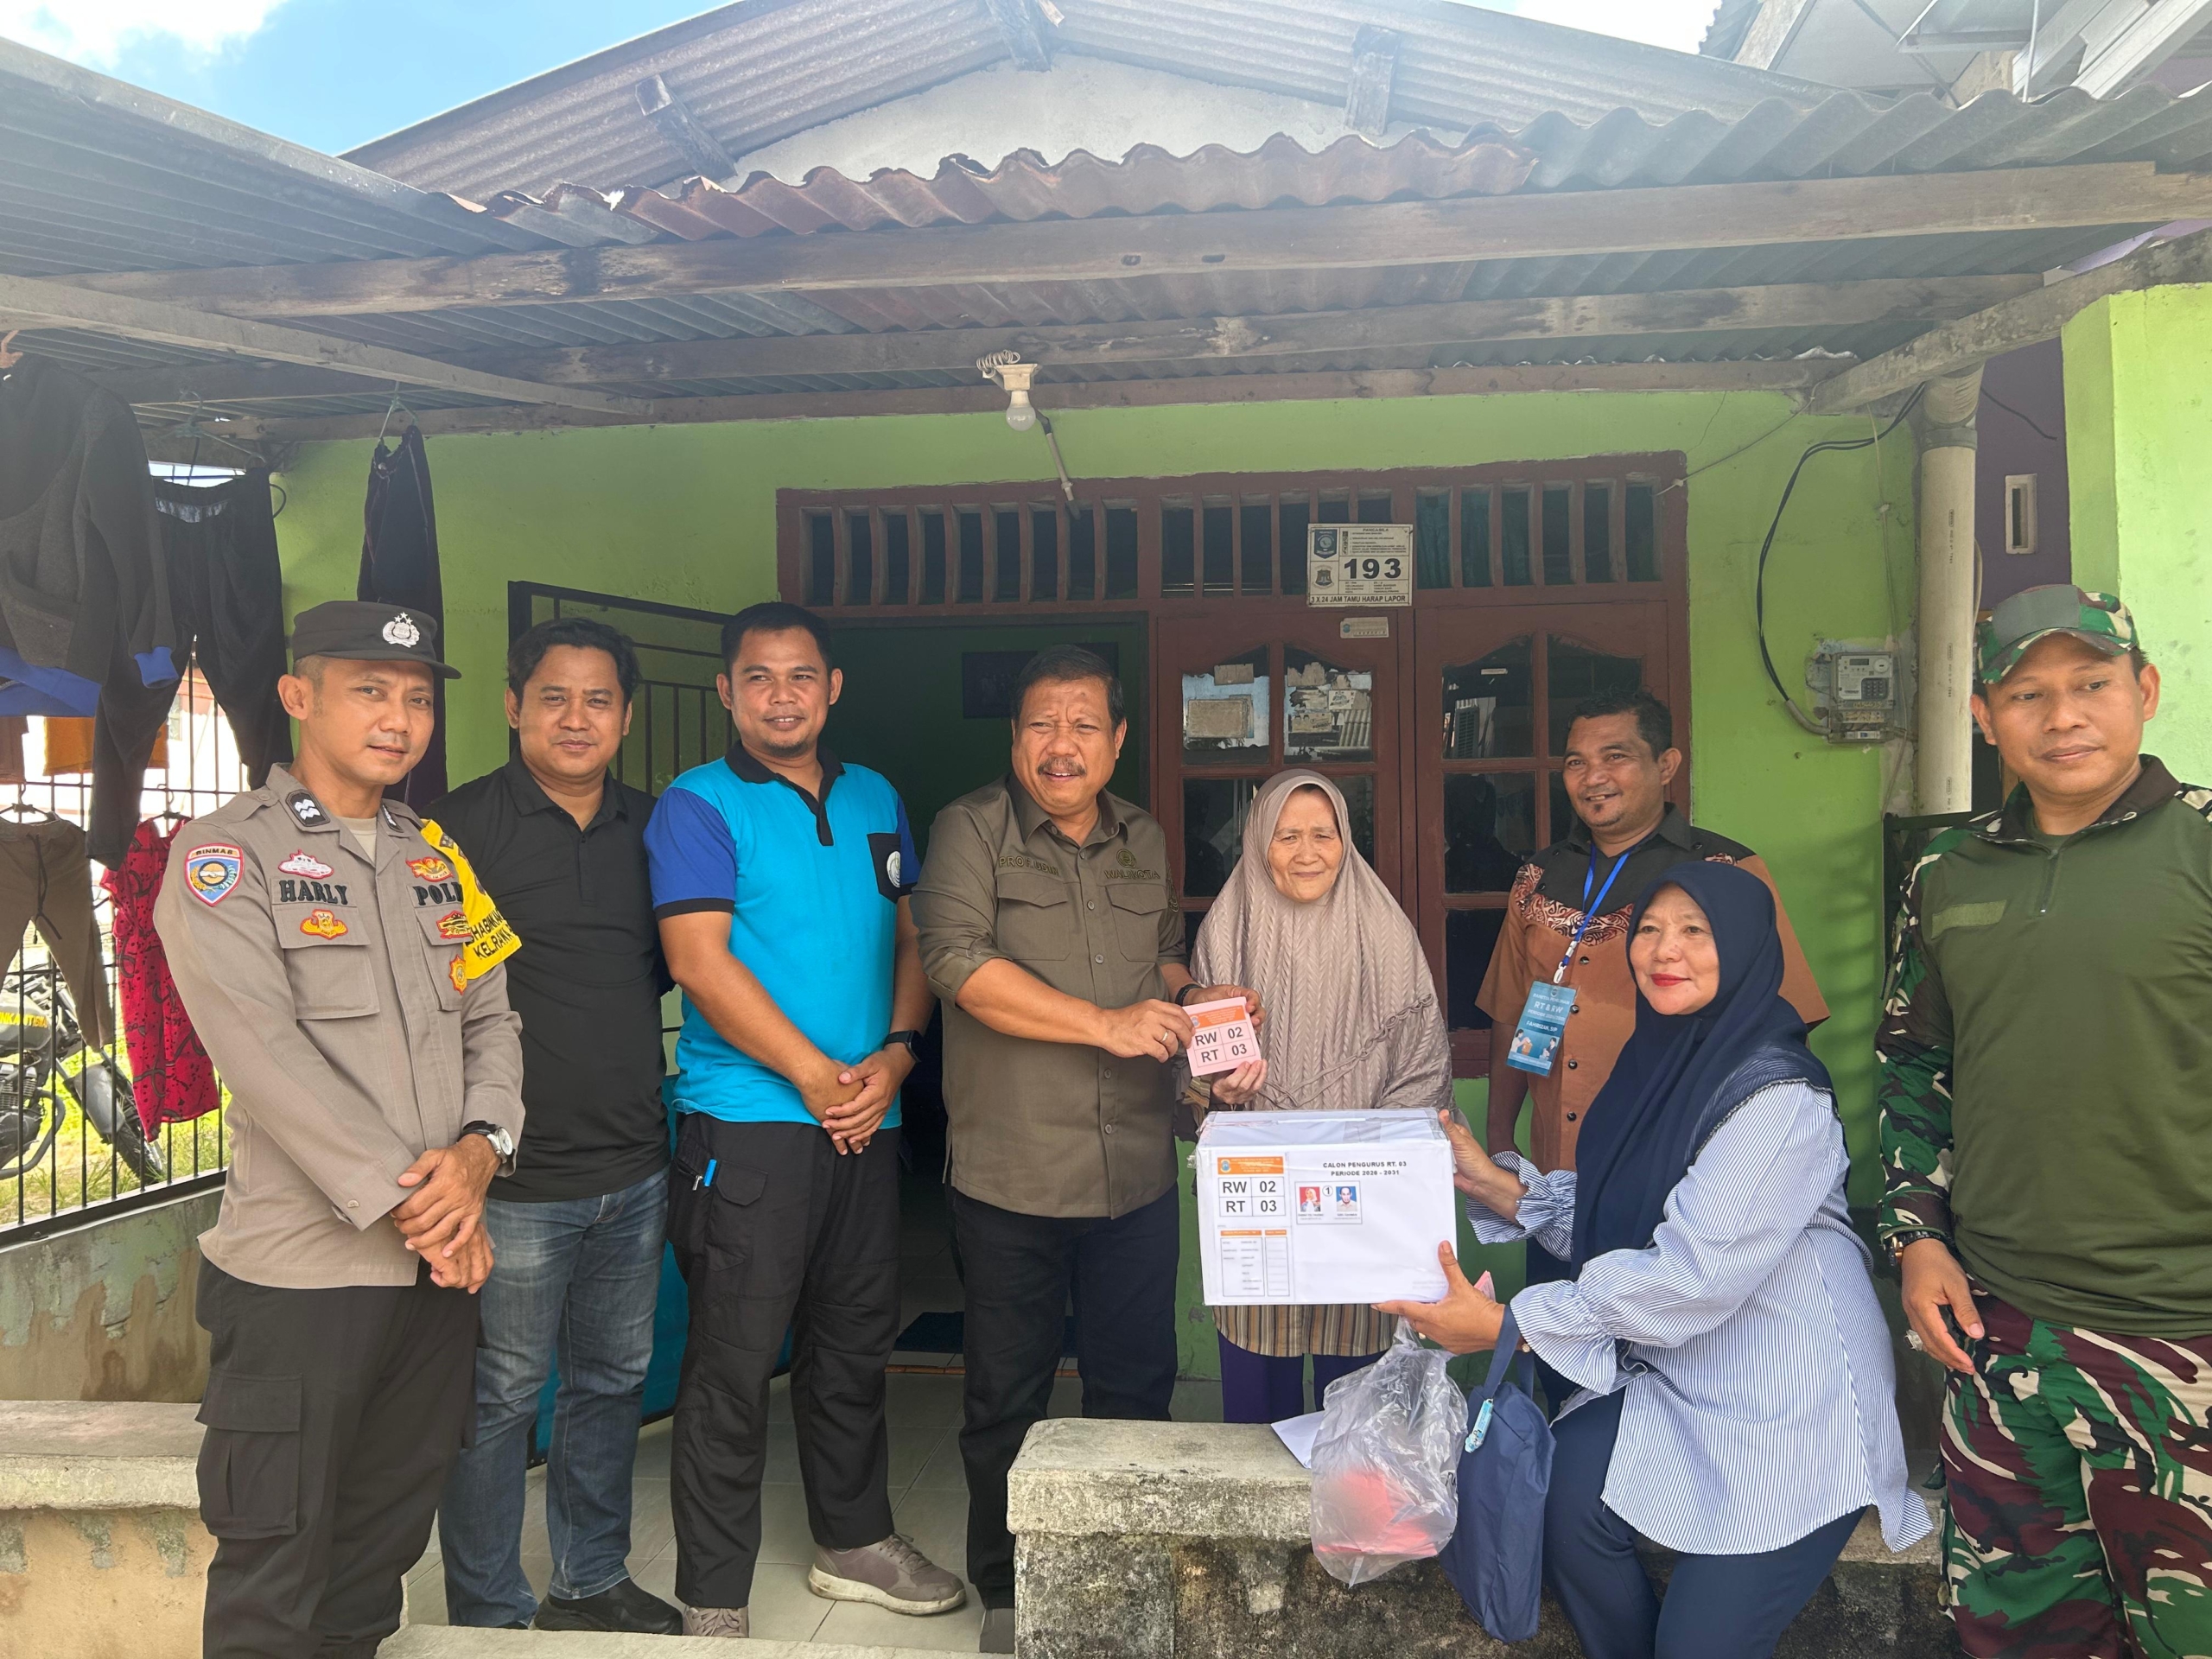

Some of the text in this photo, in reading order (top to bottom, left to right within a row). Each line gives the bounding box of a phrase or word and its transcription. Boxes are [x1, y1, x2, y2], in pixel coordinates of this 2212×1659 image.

[1344, 558, 1402, 579] 193
[1103, 869, 1161, 880] WALIKOTA
[279, 880, 348, 906] HARLY
[1534, 1001, 1546, 1009] RT
[1195, 1027, 1243, 1046] RW 02
[1201, 1043, 1248, 1063] RT 03
[1222, 1180, 1276, 1193] RW 02
[1325, 1186, 1330, 1195] 1
[1225, 1199, 1277, 1212] RT 03
